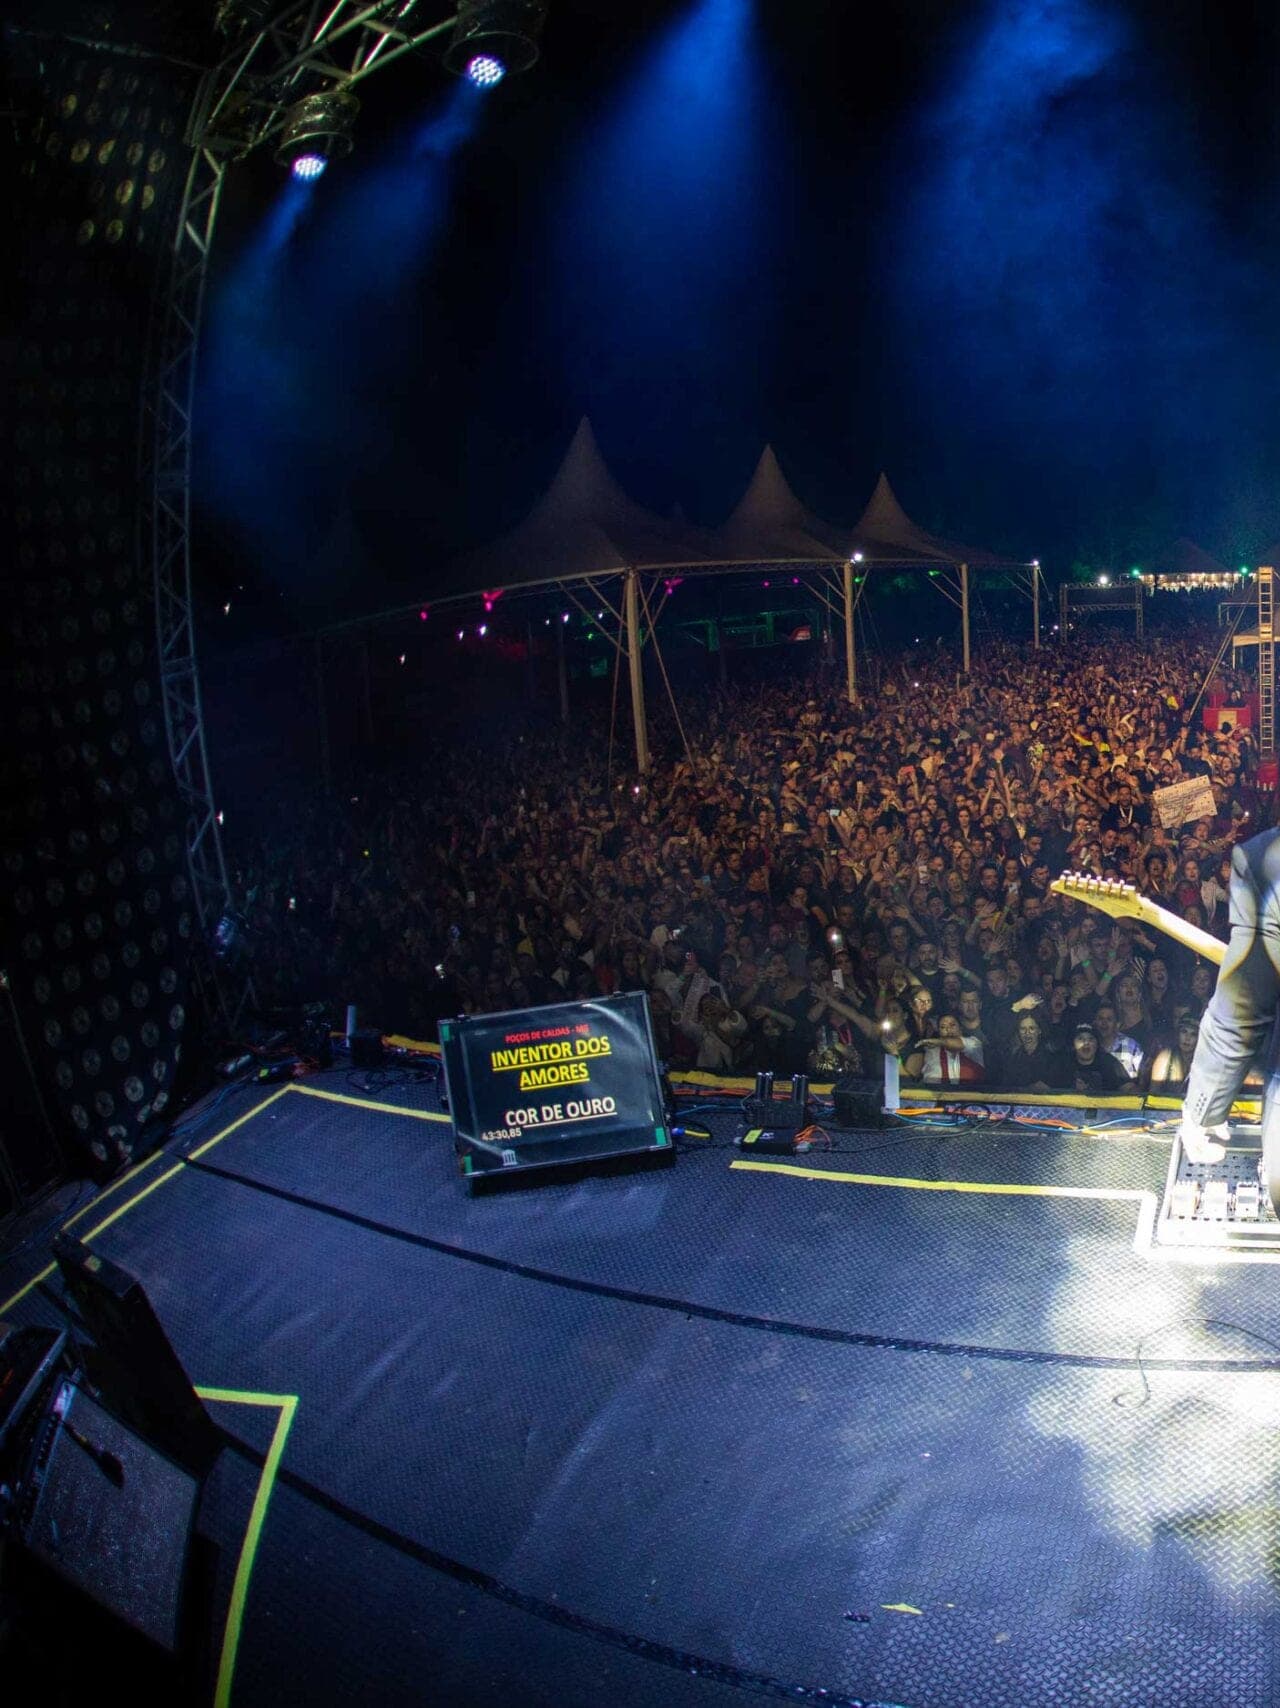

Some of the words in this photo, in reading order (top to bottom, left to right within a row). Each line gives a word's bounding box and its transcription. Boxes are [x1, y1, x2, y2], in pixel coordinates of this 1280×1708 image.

[505, 1032, 530, 1044] POÇOS
[531, 1030, 541, 1040] DE
[542, 1027, 570, 1038] CALDAS
[491, 1042, 573, 1068] INVENTOR
[575, 1036, 611, 1056] DOS
[519, 1062, 589, 1087] AMORES
[505, 1107, 539, 1127] COR
[542, 1103, 562, 1122] DE
[566, 1096, 616, 1118] OURO
